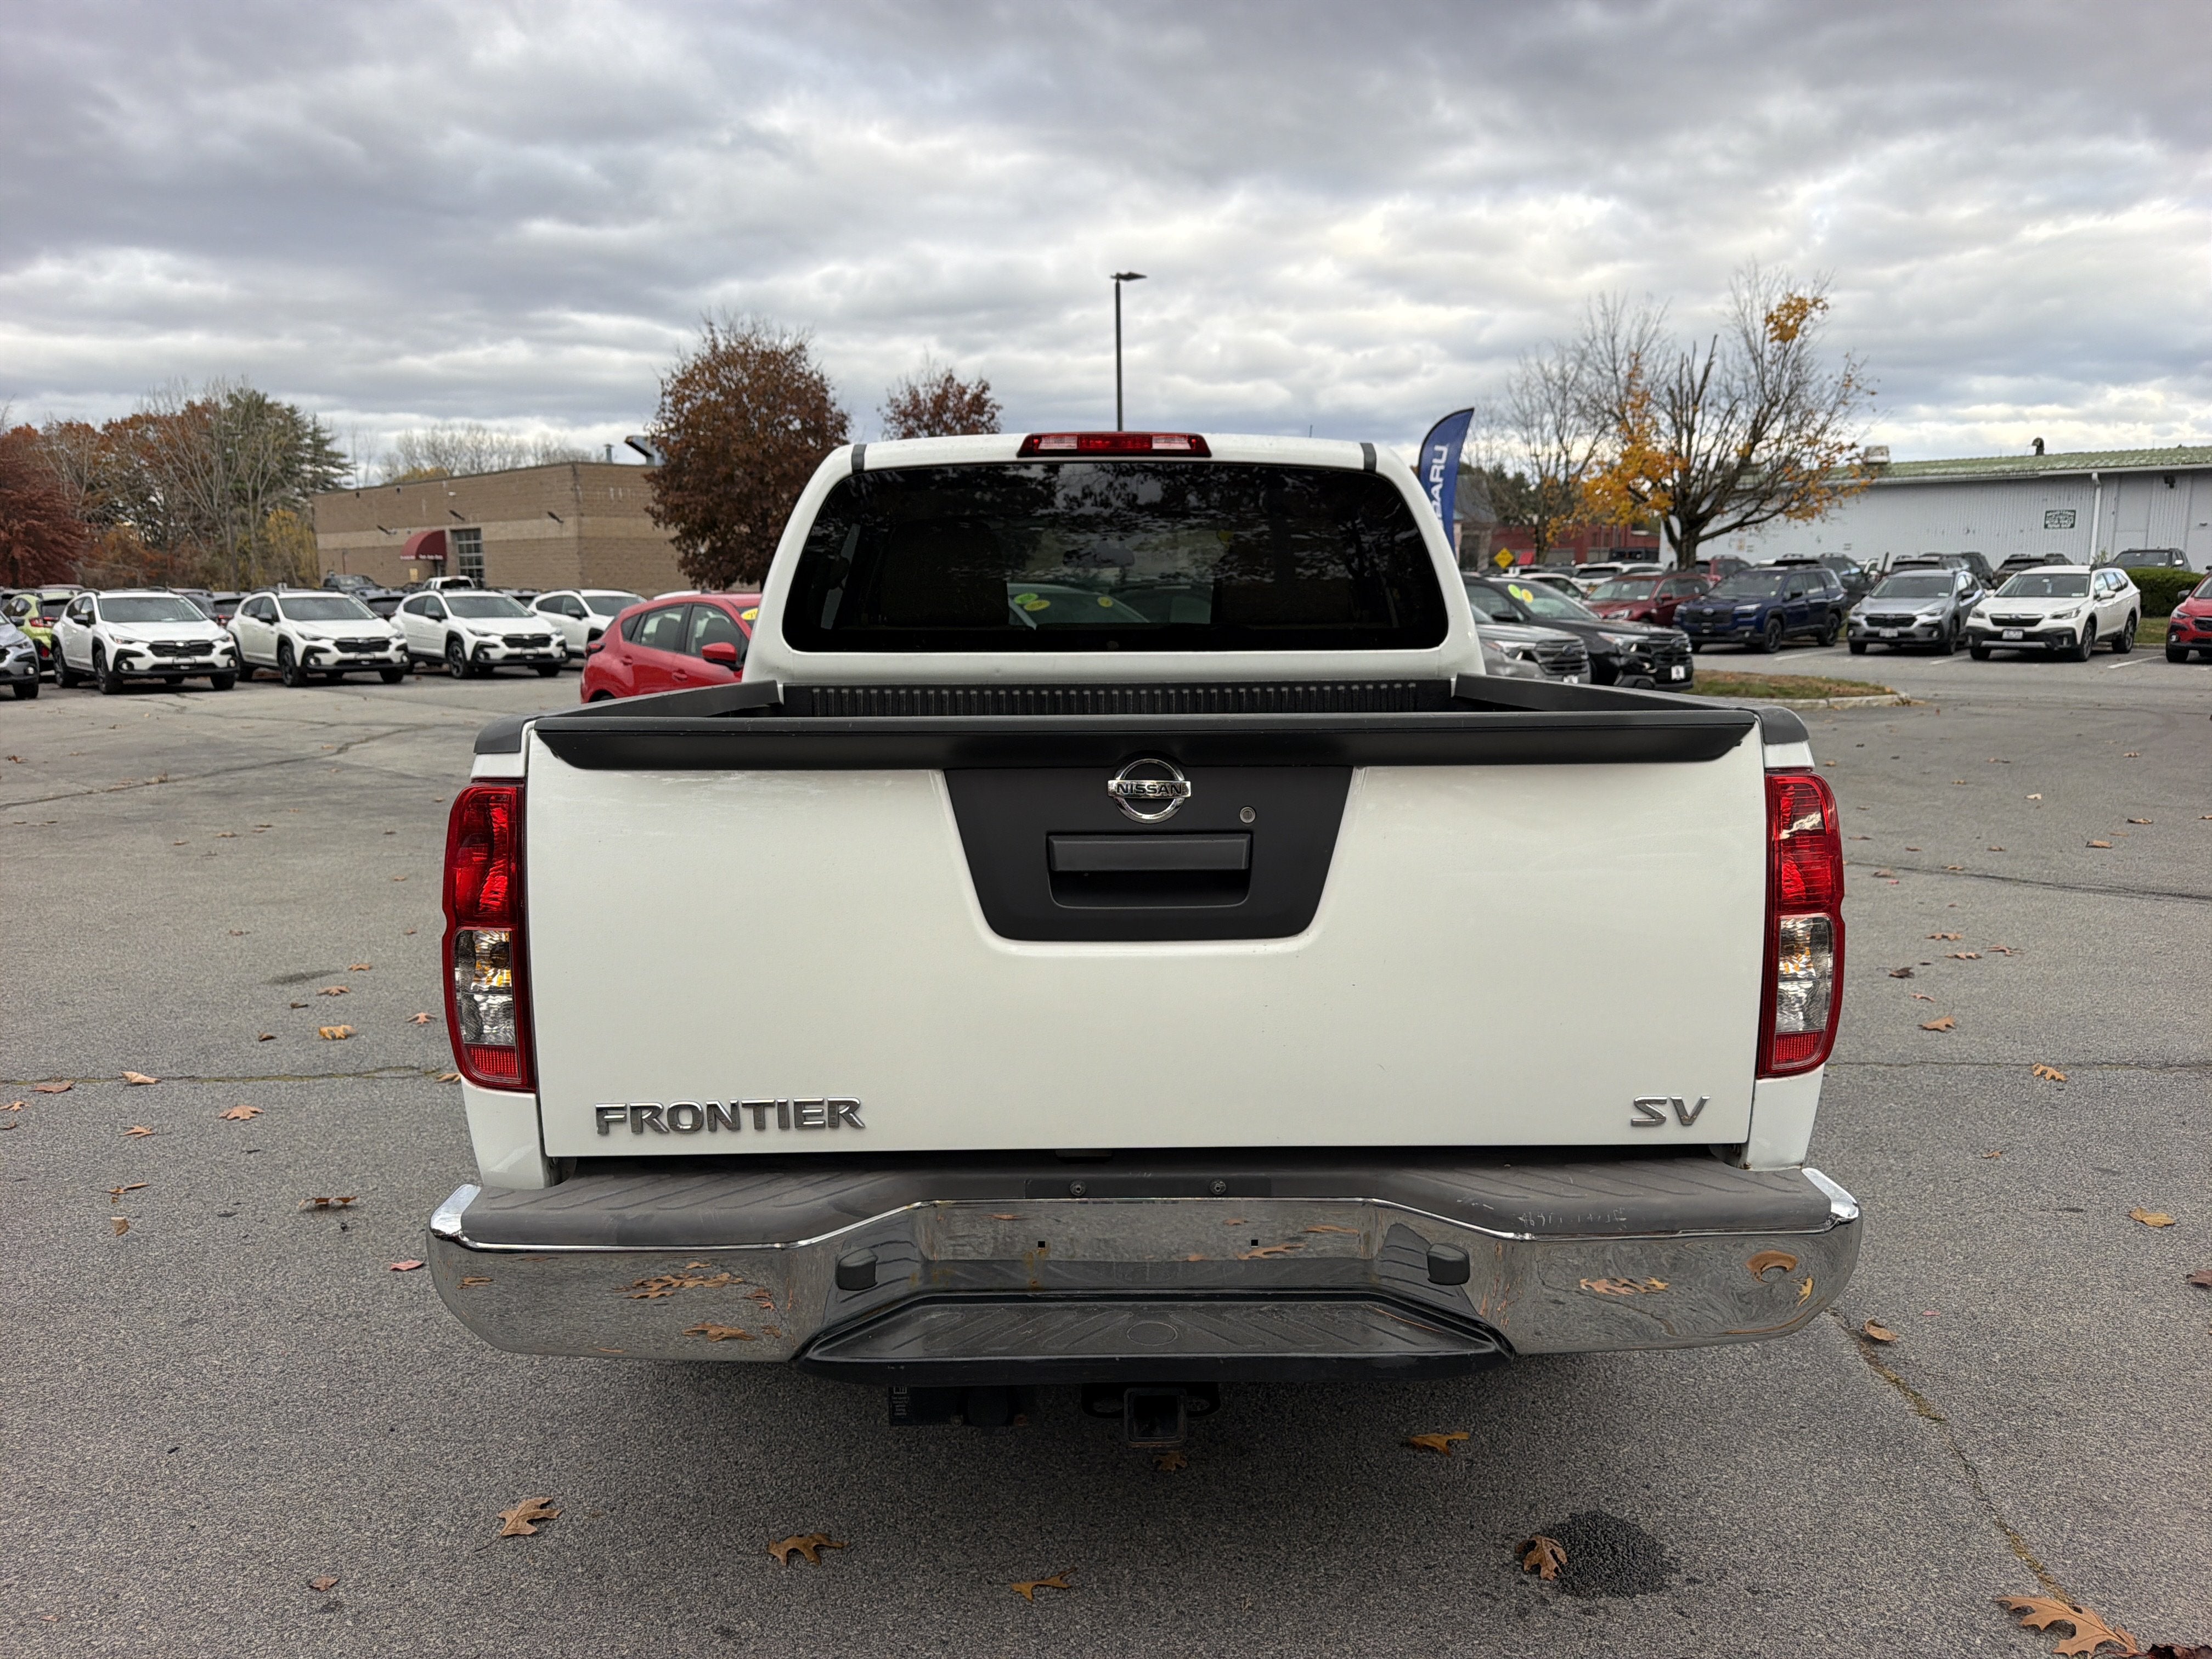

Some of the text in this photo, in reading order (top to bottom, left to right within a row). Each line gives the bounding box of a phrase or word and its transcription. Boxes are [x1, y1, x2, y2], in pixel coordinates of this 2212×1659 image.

[1116, 783, 1182, 794] NISSAN
[595, 1097, 865, 1135] FRONTIER
[1630, 1096, 1711, 1126] SV
